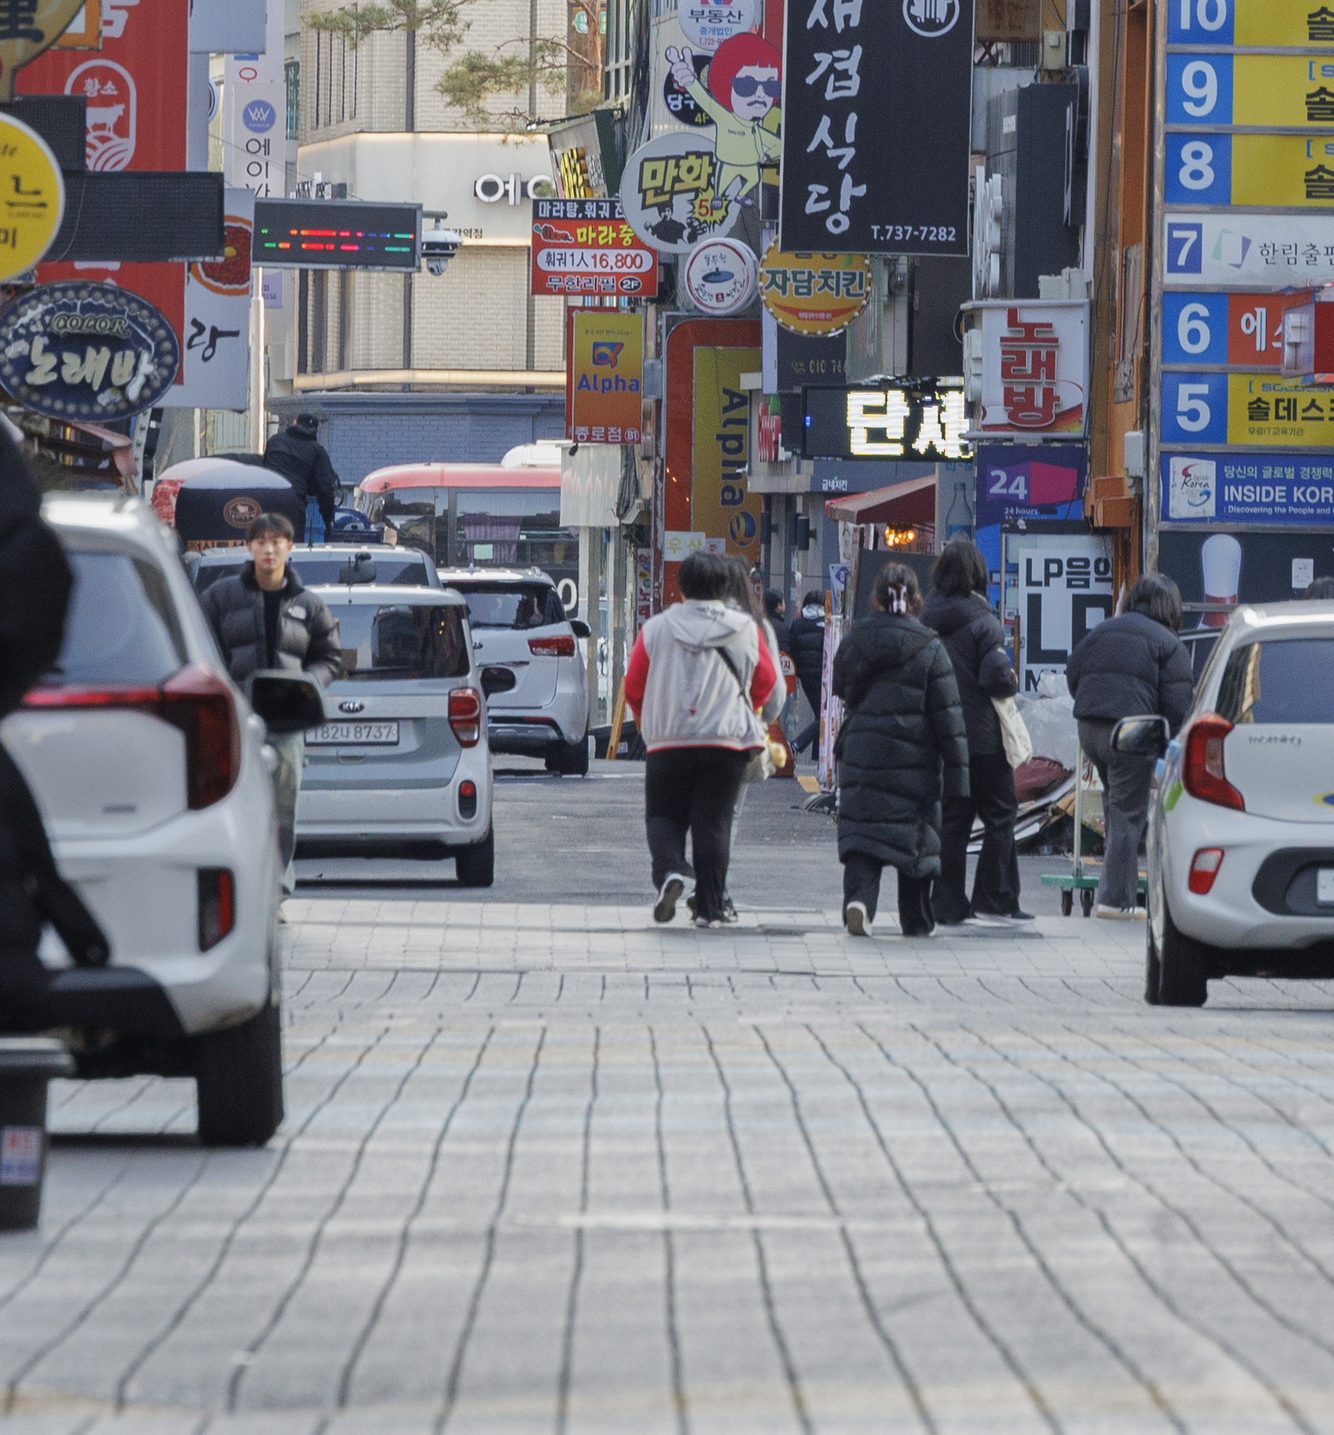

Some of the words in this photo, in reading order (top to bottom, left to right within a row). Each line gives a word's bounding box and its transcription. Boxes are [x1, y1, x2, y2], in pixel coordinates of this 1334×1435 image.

[687, 8, 744, 25] 부동산
[83, 77, 118, 97] 황소
[1181, 60, 1218, 117] 9
[1178, 140, 1215, 190] 8
[641, 153, 713, 207] 만화
[576, 225, 636, 246] 마라중
[871, 224, 957, 243] T.737-7282
[1171, 230, 1200, 265] 7
[591, 252, 643, 270] 16,800
[546, 275, 617, 293] 무한리필
[621, 278, 638, 289] 2F
[764, 268, 866, 299] 자담치킨
[53, 313, 132, 340] COLOR
[1176, 302, 1211, 355] 6
[999, 307, 1060, 427] 노래방
[576, 373, 640, 395] Alpha
[1175, 383, 1211, 433] 5
[574, 425, 622, 443] 종로점
[719, 387, 749, 509] Alpha
[1223, 465, 1259, 480] 당신의
[1262, 465, 1295, 480] 글로벌
[988, 469, 1028, 501] 24
[1223, 484, 1290, 503] INSIDE
[1004, 507, 1015, 515] 24
[1015, 507, 1038, 515] hours
[1273, 505, 1288, 515] the
[1288, 505, 1314, 517] People
[1315, 506, 1331, 516] and
[342, 703, 361, 713] KIA
[353, 720, 394, 740] 8737
